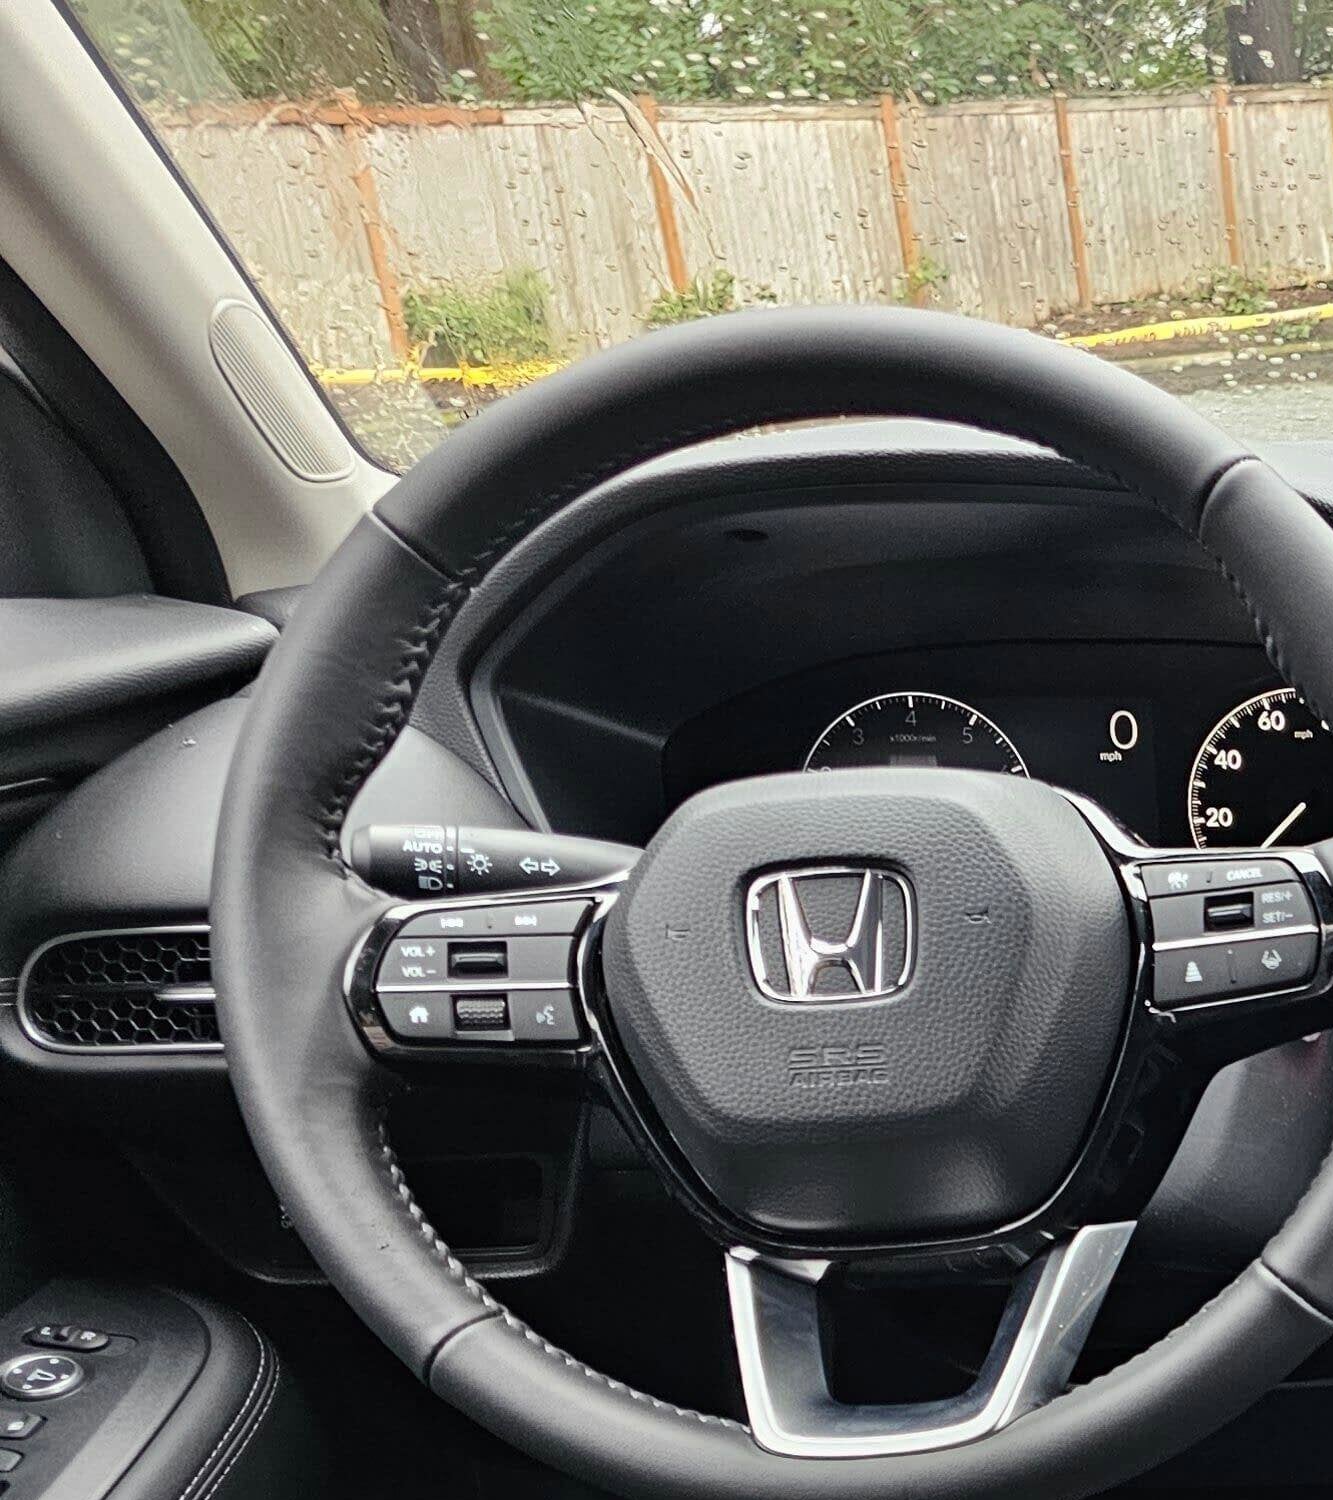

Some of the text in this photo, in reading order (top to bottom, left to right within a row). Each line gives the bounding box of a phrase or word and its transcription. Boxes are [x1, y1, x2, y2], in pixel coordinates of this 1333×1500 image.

[905, 710, 917, 726] 4
[1257, 710, 1286, 731] 60
[853, 728, 865, 746] 3
[962, 727, 974, 744] 5
[1109, 710, 1138, 750] 0
[1100, 750, 1122, 762] mph
[1214, 749, 1242, 770] 40
[1205, 807, 1233, 827] 20
[402, 839, 443, 854] AUTO
